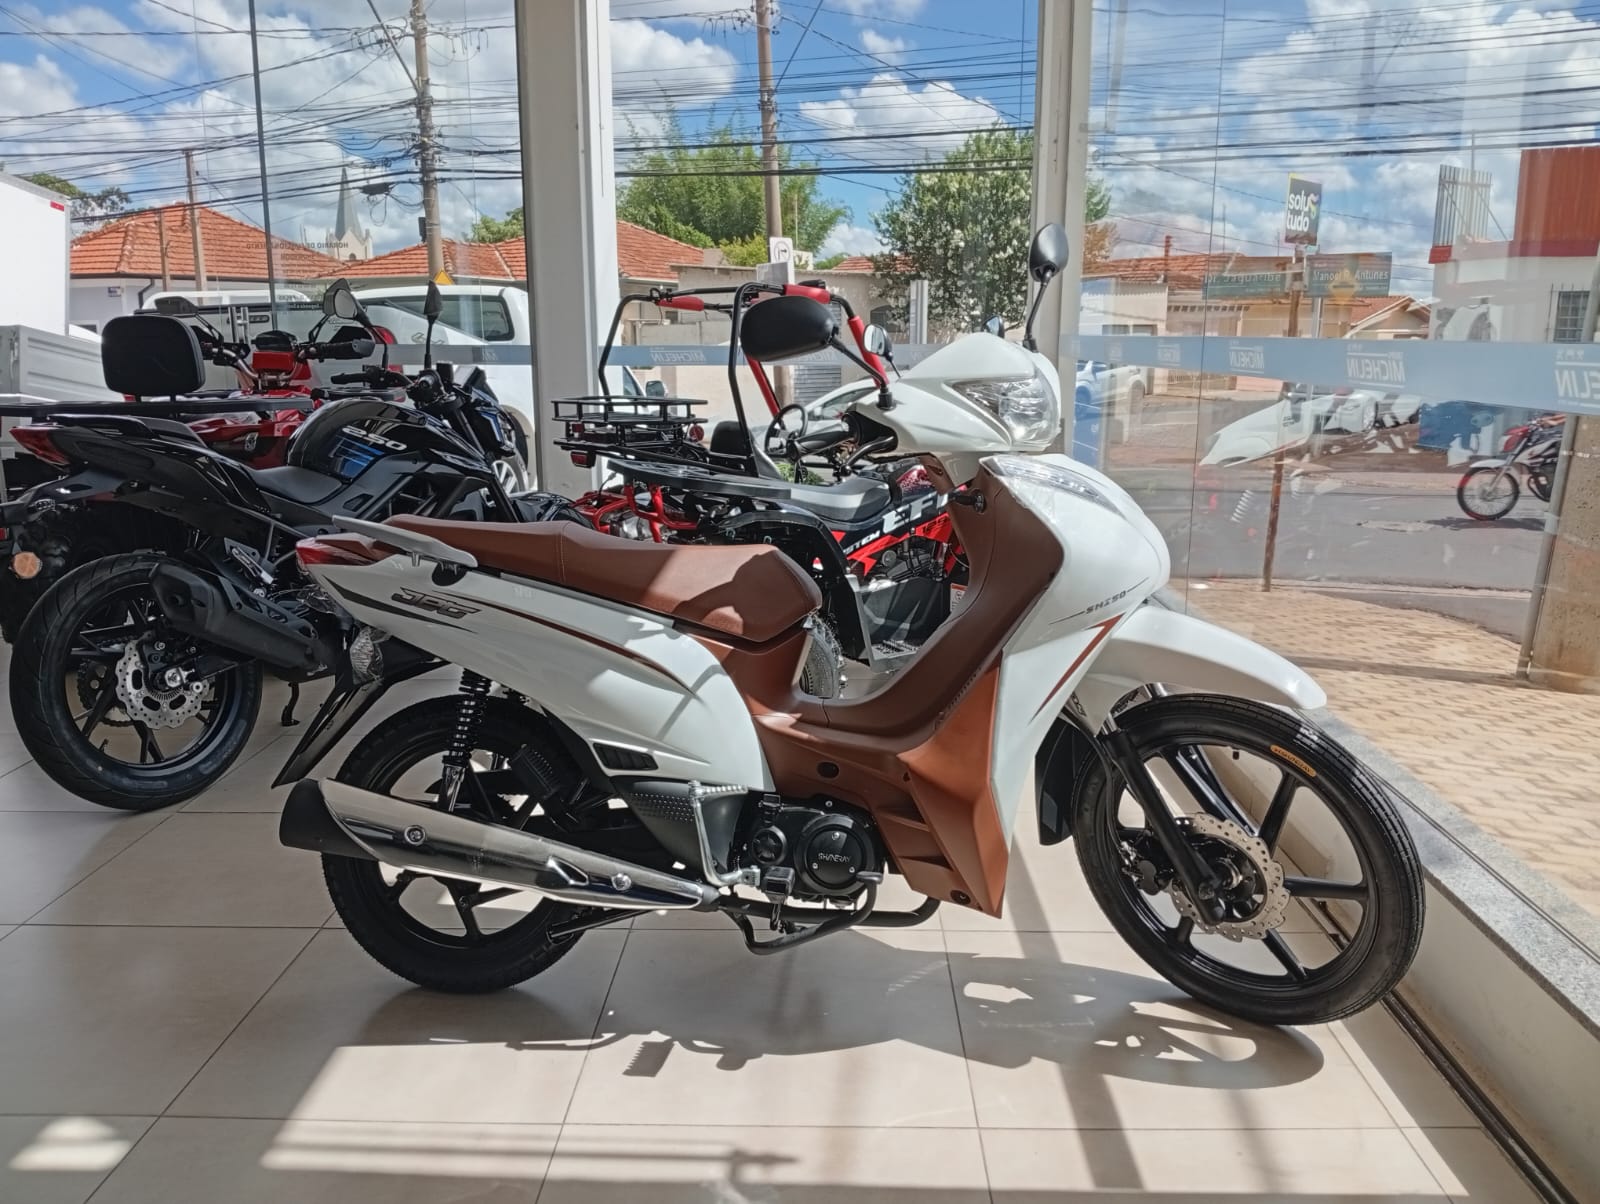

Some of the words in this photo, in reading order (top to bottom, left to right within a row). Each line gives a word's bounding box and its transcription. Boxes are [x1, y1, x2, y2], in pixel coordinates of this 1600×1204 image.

[1288, 190, 1310, 211] solu
[1286, 211, 1309, 232] tudo
[1354, 269, 1389, 281] Antunes
[342, 425, 408, 451] 250
